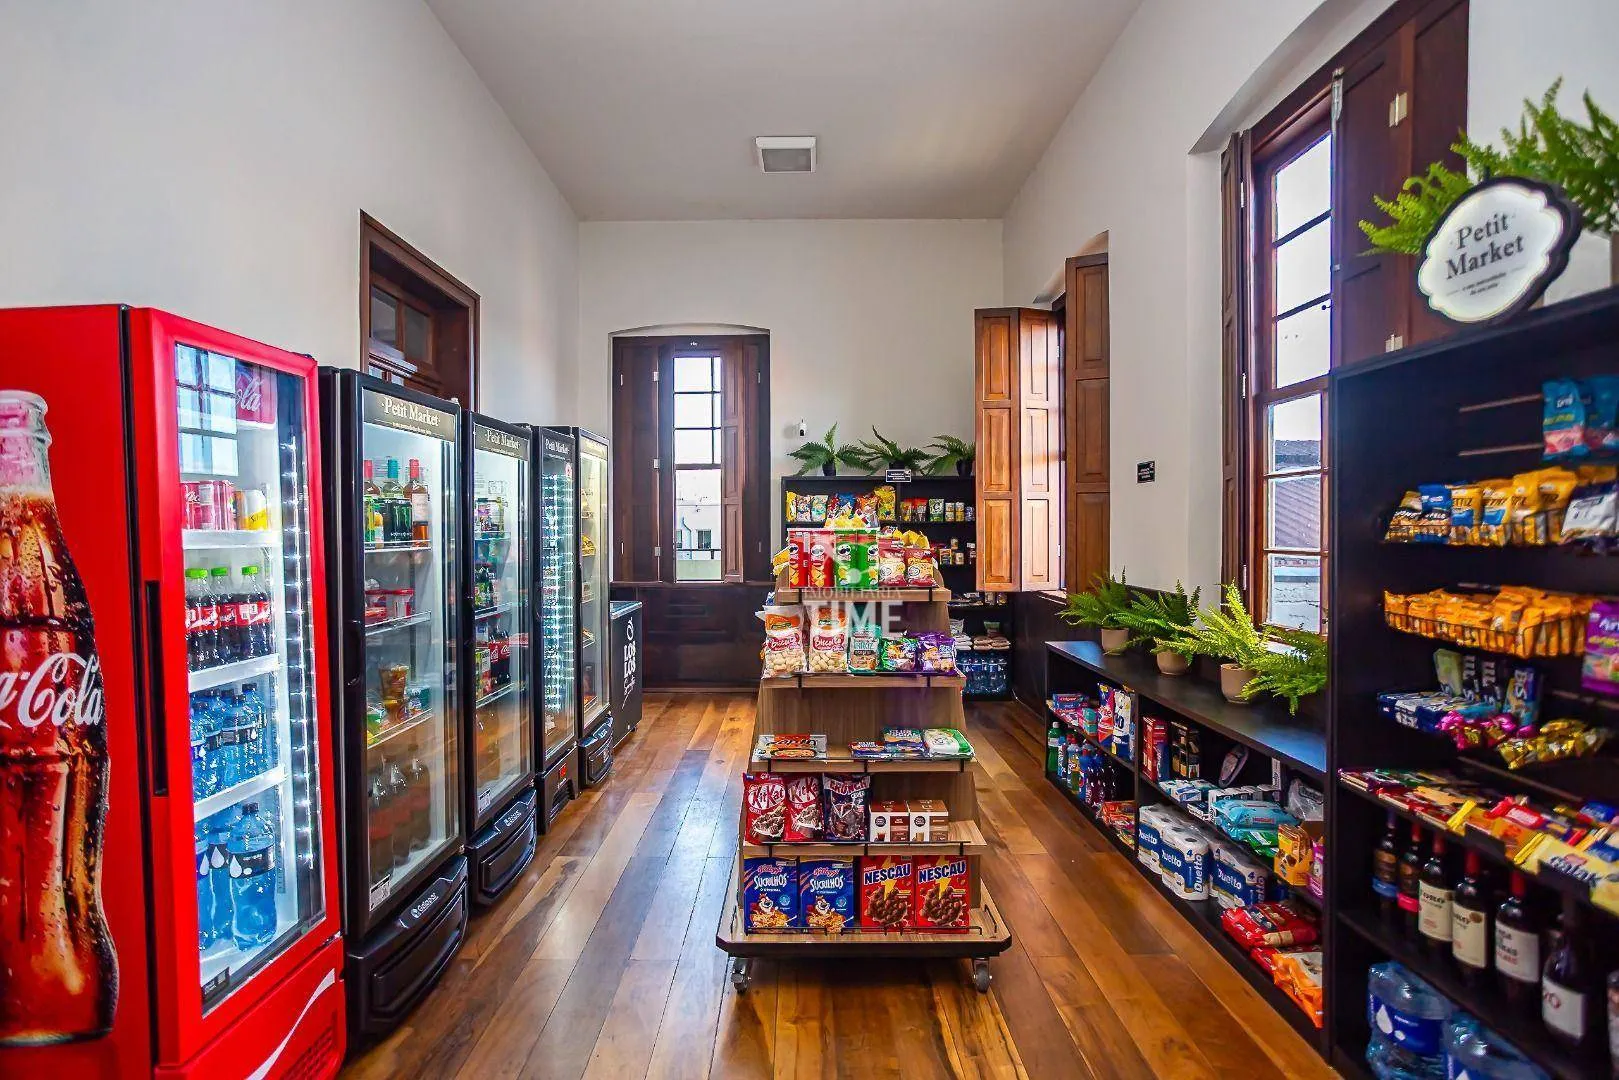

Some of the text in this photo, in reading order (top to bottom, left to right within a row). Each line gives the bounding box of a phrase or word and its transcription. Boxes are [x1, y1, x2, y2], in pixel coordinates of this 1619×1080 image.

[1456, 212, 1509, 250] Petit
[1446, 234, 1525, 280] Market
[384, 396, 439, 427] Petit Market
[749, 784, 785, 810] KitKat
[753, 872, 788, 891] SUCRILHOS
[809, 875, 844, 892] SUCRILHOS
[863, 862, 912, 886] NESCAU
[917, 860, 967, 885] NESCAU
[1193, 853, 1204, 893] Duetto
